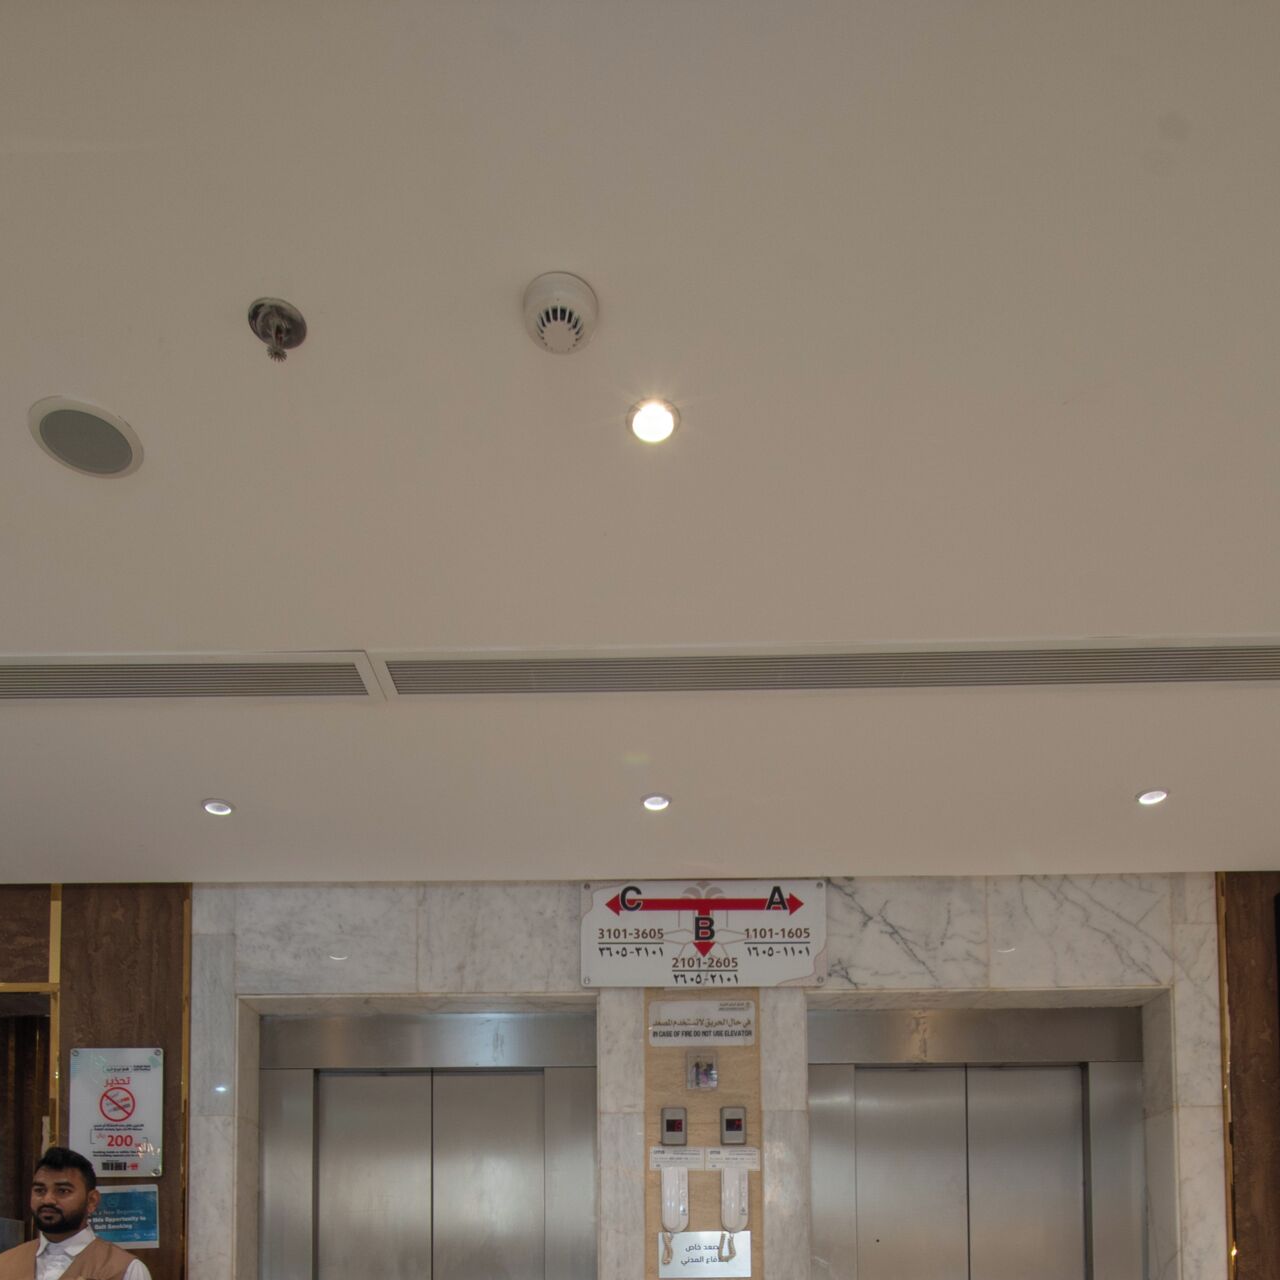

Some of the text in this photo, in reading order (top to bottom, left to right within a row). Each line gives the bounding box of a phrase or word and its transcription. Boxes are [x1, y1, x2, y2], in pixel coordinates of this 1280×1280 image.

[620, 885, 642, 911] C
[765, 885, 788, 911] A
[598, 928, 664, 939] 3101-3605
[694, 916, 715, 941] B
[744, 928, 811, 939] 1101-1605
[672, 957, 738, 968] 2101-2605
[659, 1030, 673, 1038] CASE
[673, 1030, 680, 1038] OF
[681, 1030, 692, 1038] FIRE
[693, 1030, 701, 1038] DO
[104, 1076, 131, 1088] تحذير
[107, 1134, 133, 1147] 200
[105, 1215, 139, 1223] Opportunity
